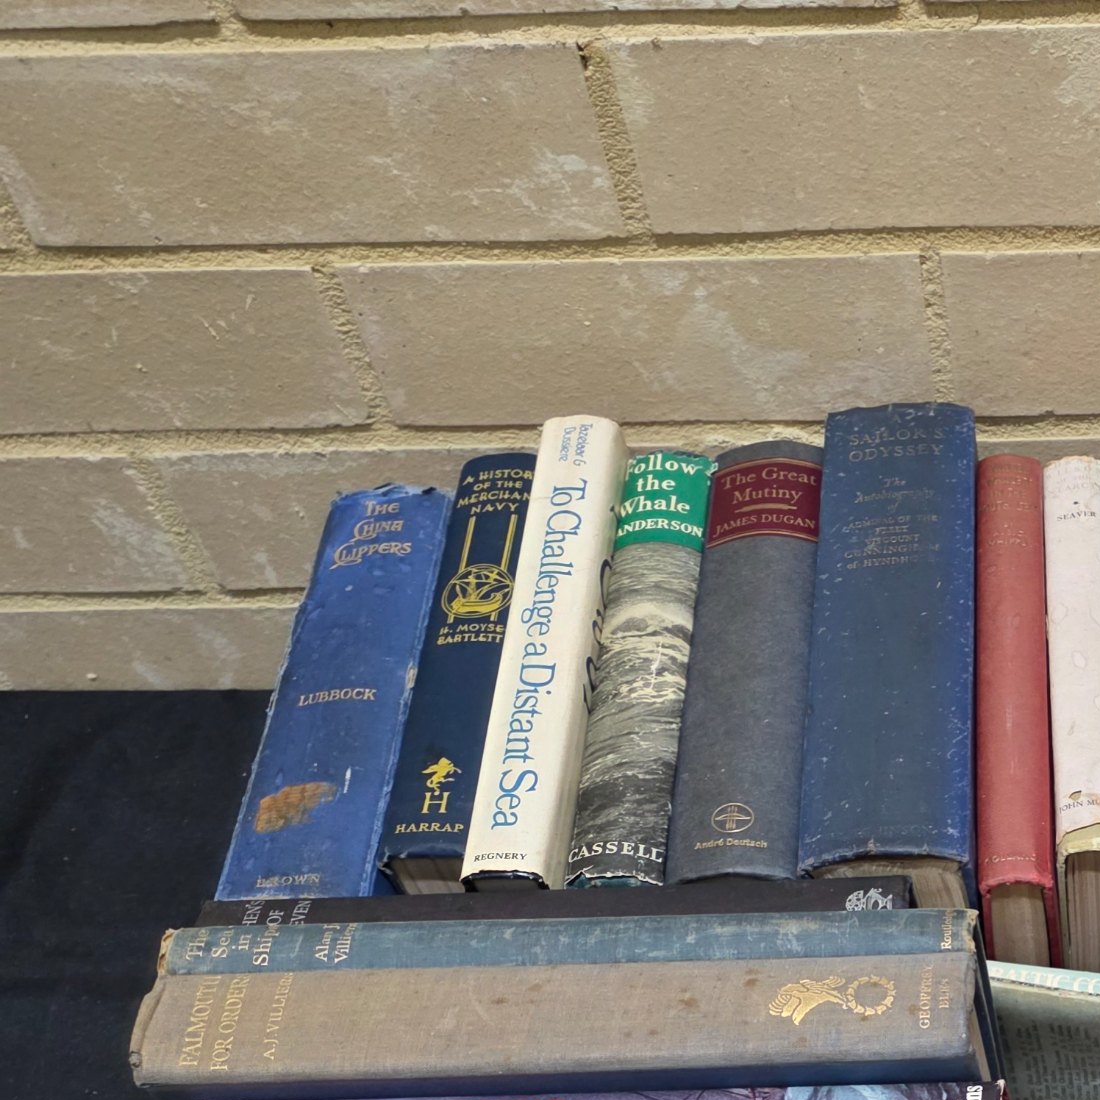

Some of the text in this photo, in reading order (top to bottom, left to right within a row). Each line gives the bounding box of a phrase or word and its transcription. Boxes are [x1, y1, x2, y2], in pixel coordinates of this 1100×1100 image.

[849, 445, 944, 463] ODYSSEY
[636, 475, 676, 491] the
[732, 485, 803, 505] Mutiny
[470, 502, 519, 515] NAVY
[619, 496, 690, 518] Whale
[1056, 510, 1096, 522] SEAVER
[617, 518, 703, 538] ANDERSON
[712, 513, 815, 537] JAMES DUGAN
[491, 477, 589, 831] To Challenge a Distant Sea
[298, 688, 377, 707] LUBBOCK
[394, 821, 464, 834] HARRAP
[568, 840, 663, 864] CASSELL
[186, 929, 210, 961] The
[919, 964, 934, 1029] GEOFFREY
